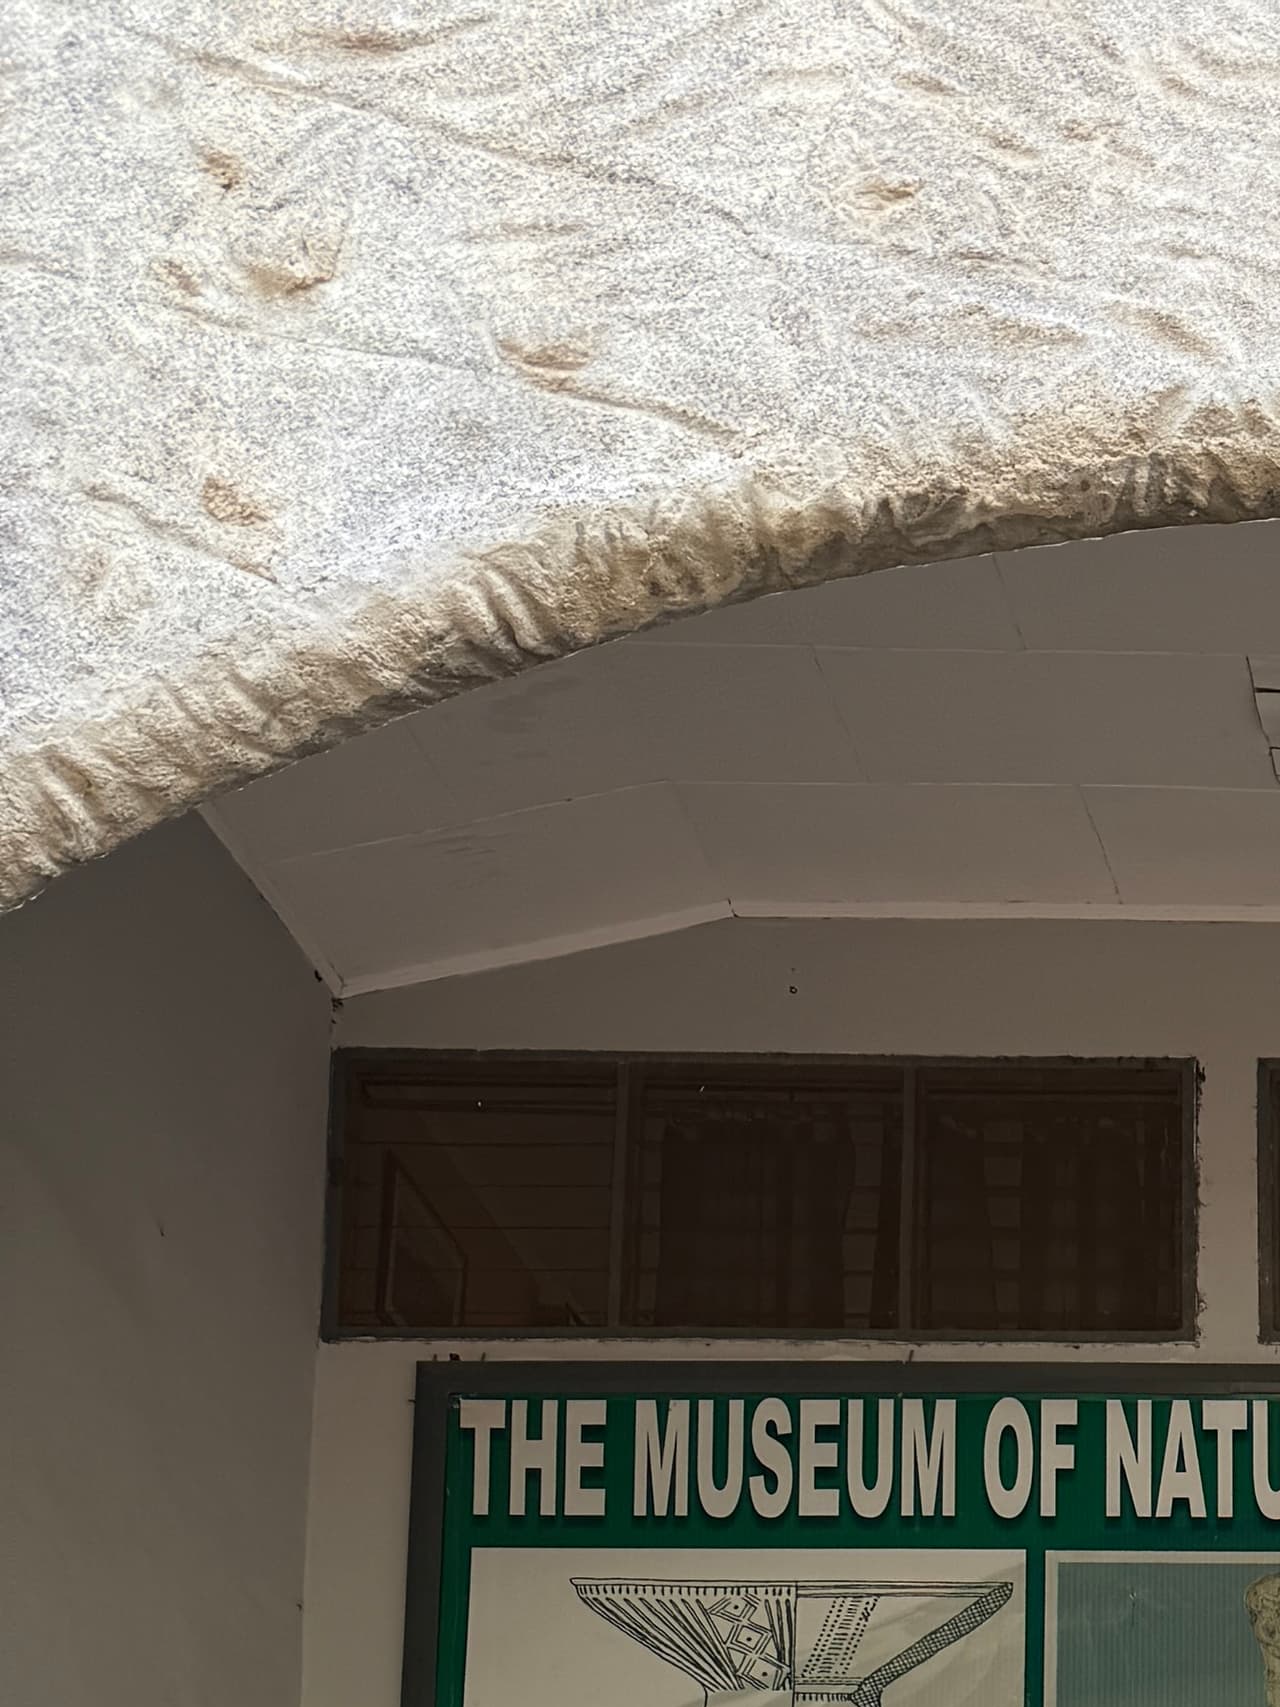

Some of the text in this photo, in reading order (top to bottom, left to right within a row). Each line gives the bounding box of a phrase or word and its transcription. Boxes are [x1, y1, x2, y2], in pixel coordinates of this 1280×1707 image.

[459, 1398, 607, 1516] THE
[633, 1397, 957, 1519] MUSEUM
[983, 1396, 1079, 1519] OF
